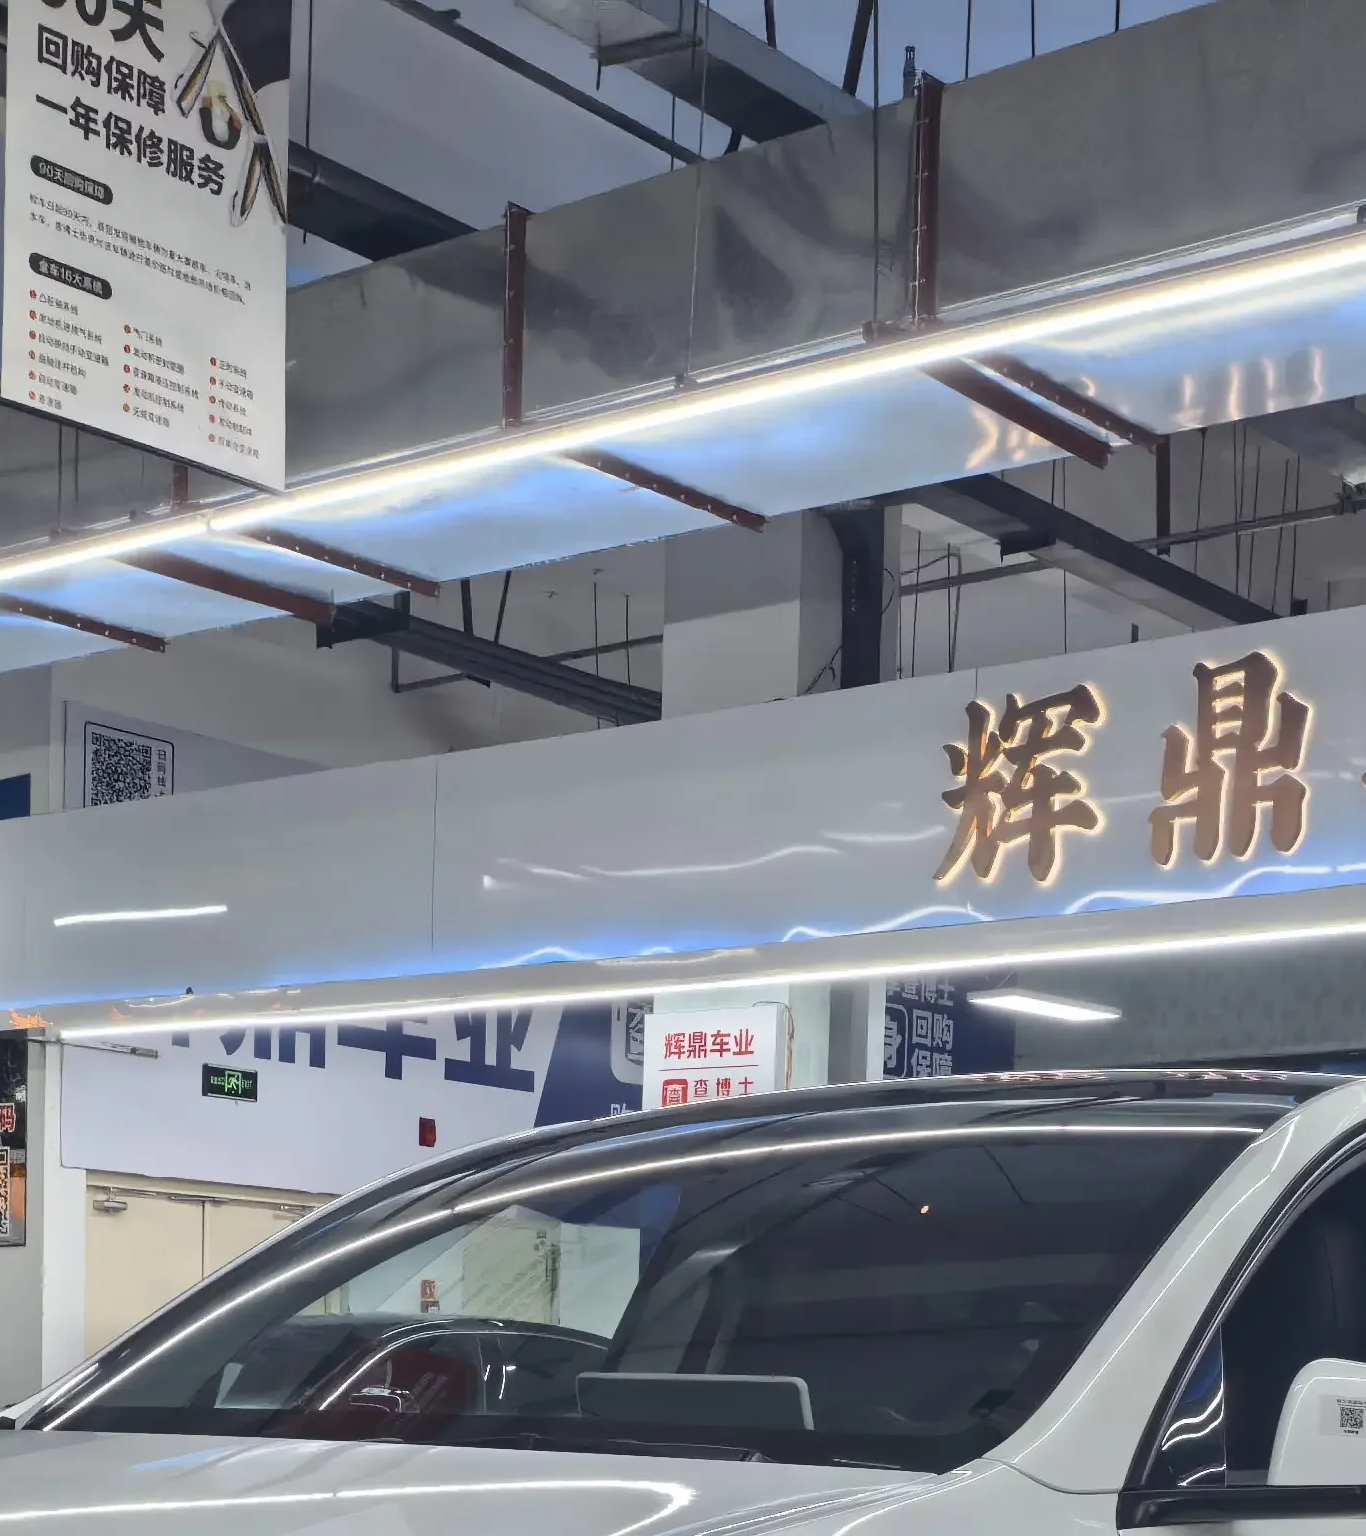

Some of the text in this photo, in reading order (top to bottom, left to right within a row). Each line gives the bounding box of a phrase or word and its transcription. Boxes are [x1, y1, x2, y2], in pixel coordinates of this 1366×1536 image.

[40, 0, 165, 62] 0天
[38, 23, 167, 116] 回购保障
[35, 94, 225, 196] 一年保修服务
[664, 1028, 755, 1060] 辉鼎车业
[911, 1008, 954, 1051] 回购
[693, 1077, 754, 1098] 查博士
